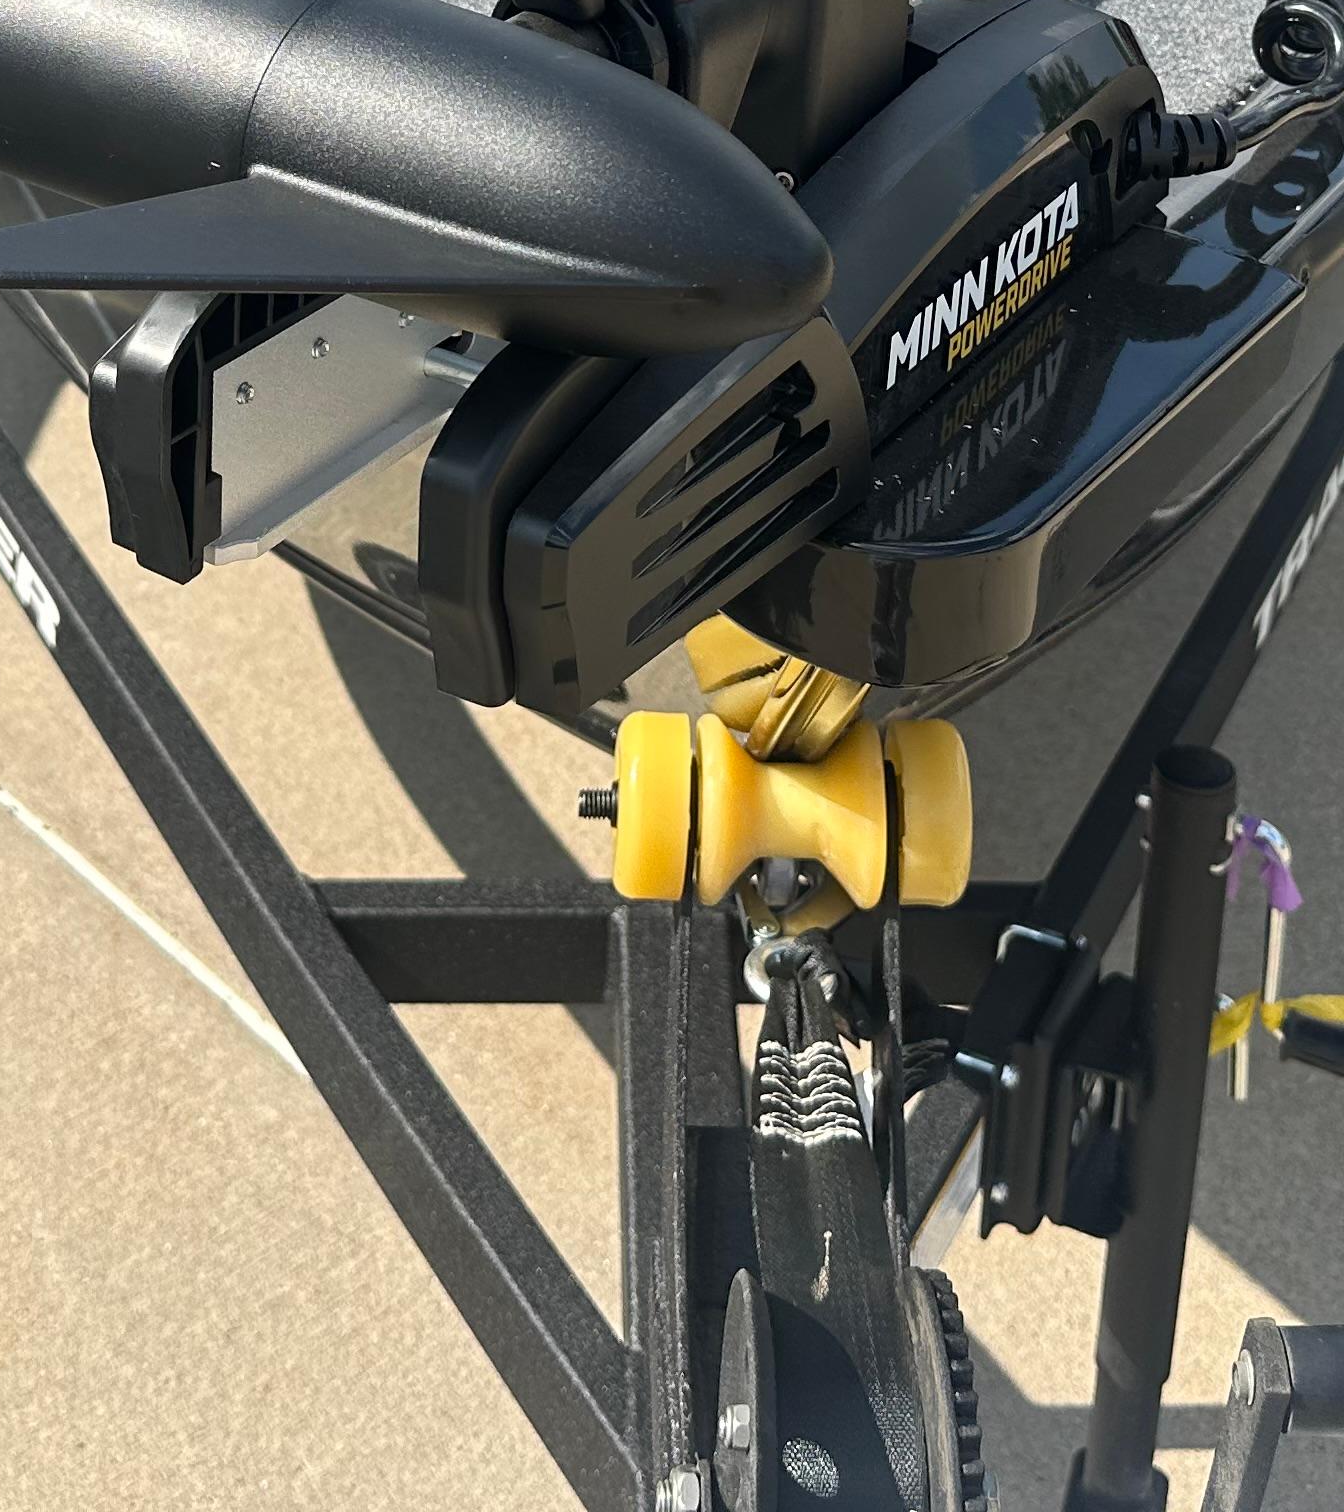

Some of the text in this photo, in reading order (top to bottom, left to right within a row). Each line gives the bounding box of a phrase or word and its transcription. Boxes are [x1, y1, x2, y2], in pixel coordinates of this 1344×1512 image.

[886, 181, 1080, 391] MINN KOTA
[946, 234, 1073, 373] POWERDRIVE
